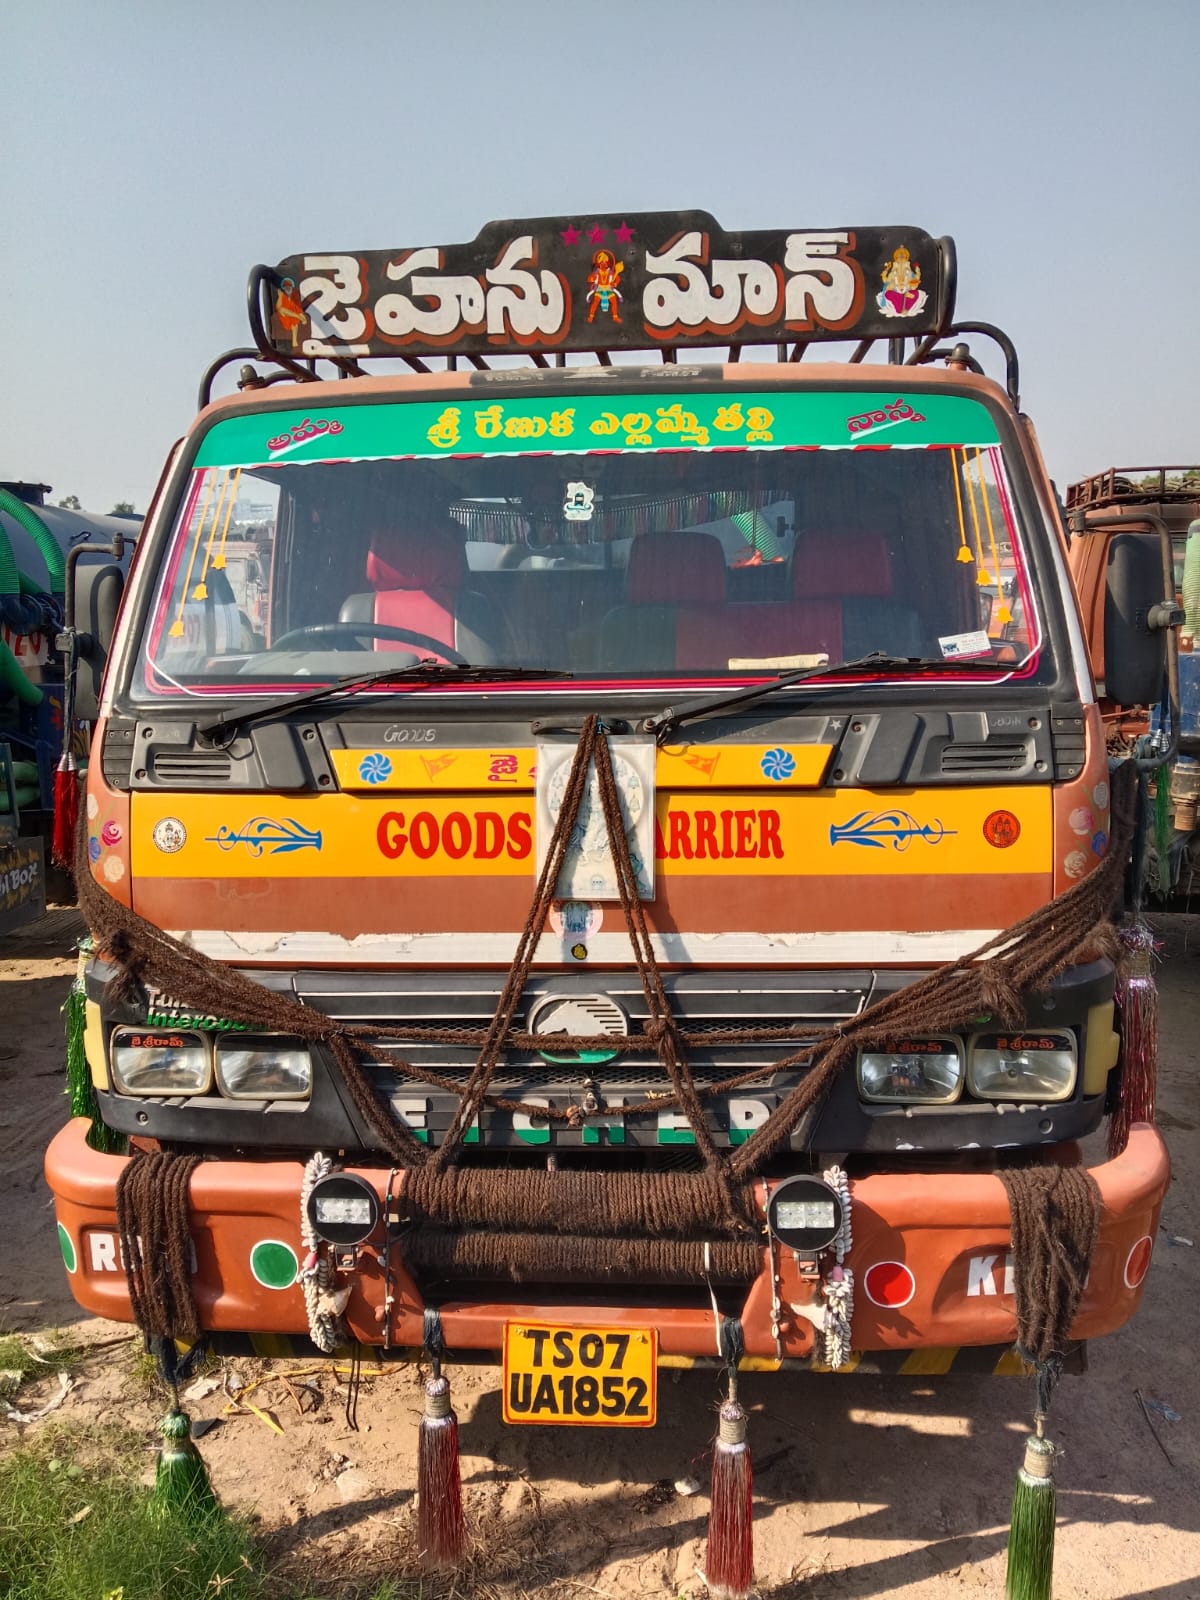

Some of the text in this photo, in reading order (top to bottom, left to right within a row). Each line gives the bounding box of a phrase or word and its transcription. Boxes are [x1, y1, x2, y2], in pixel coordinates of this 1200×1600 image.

[299, 255, 370, 357] జై
[427, 402, 775, 448] శ్రీ రేణుక ఎల్లమ్మ తల్లి
[376, 808, 785, 860] GOODS RRIER
[527, 1329, 631, 1370] TS07
[509, 1372, 649, 1417] UA1852
